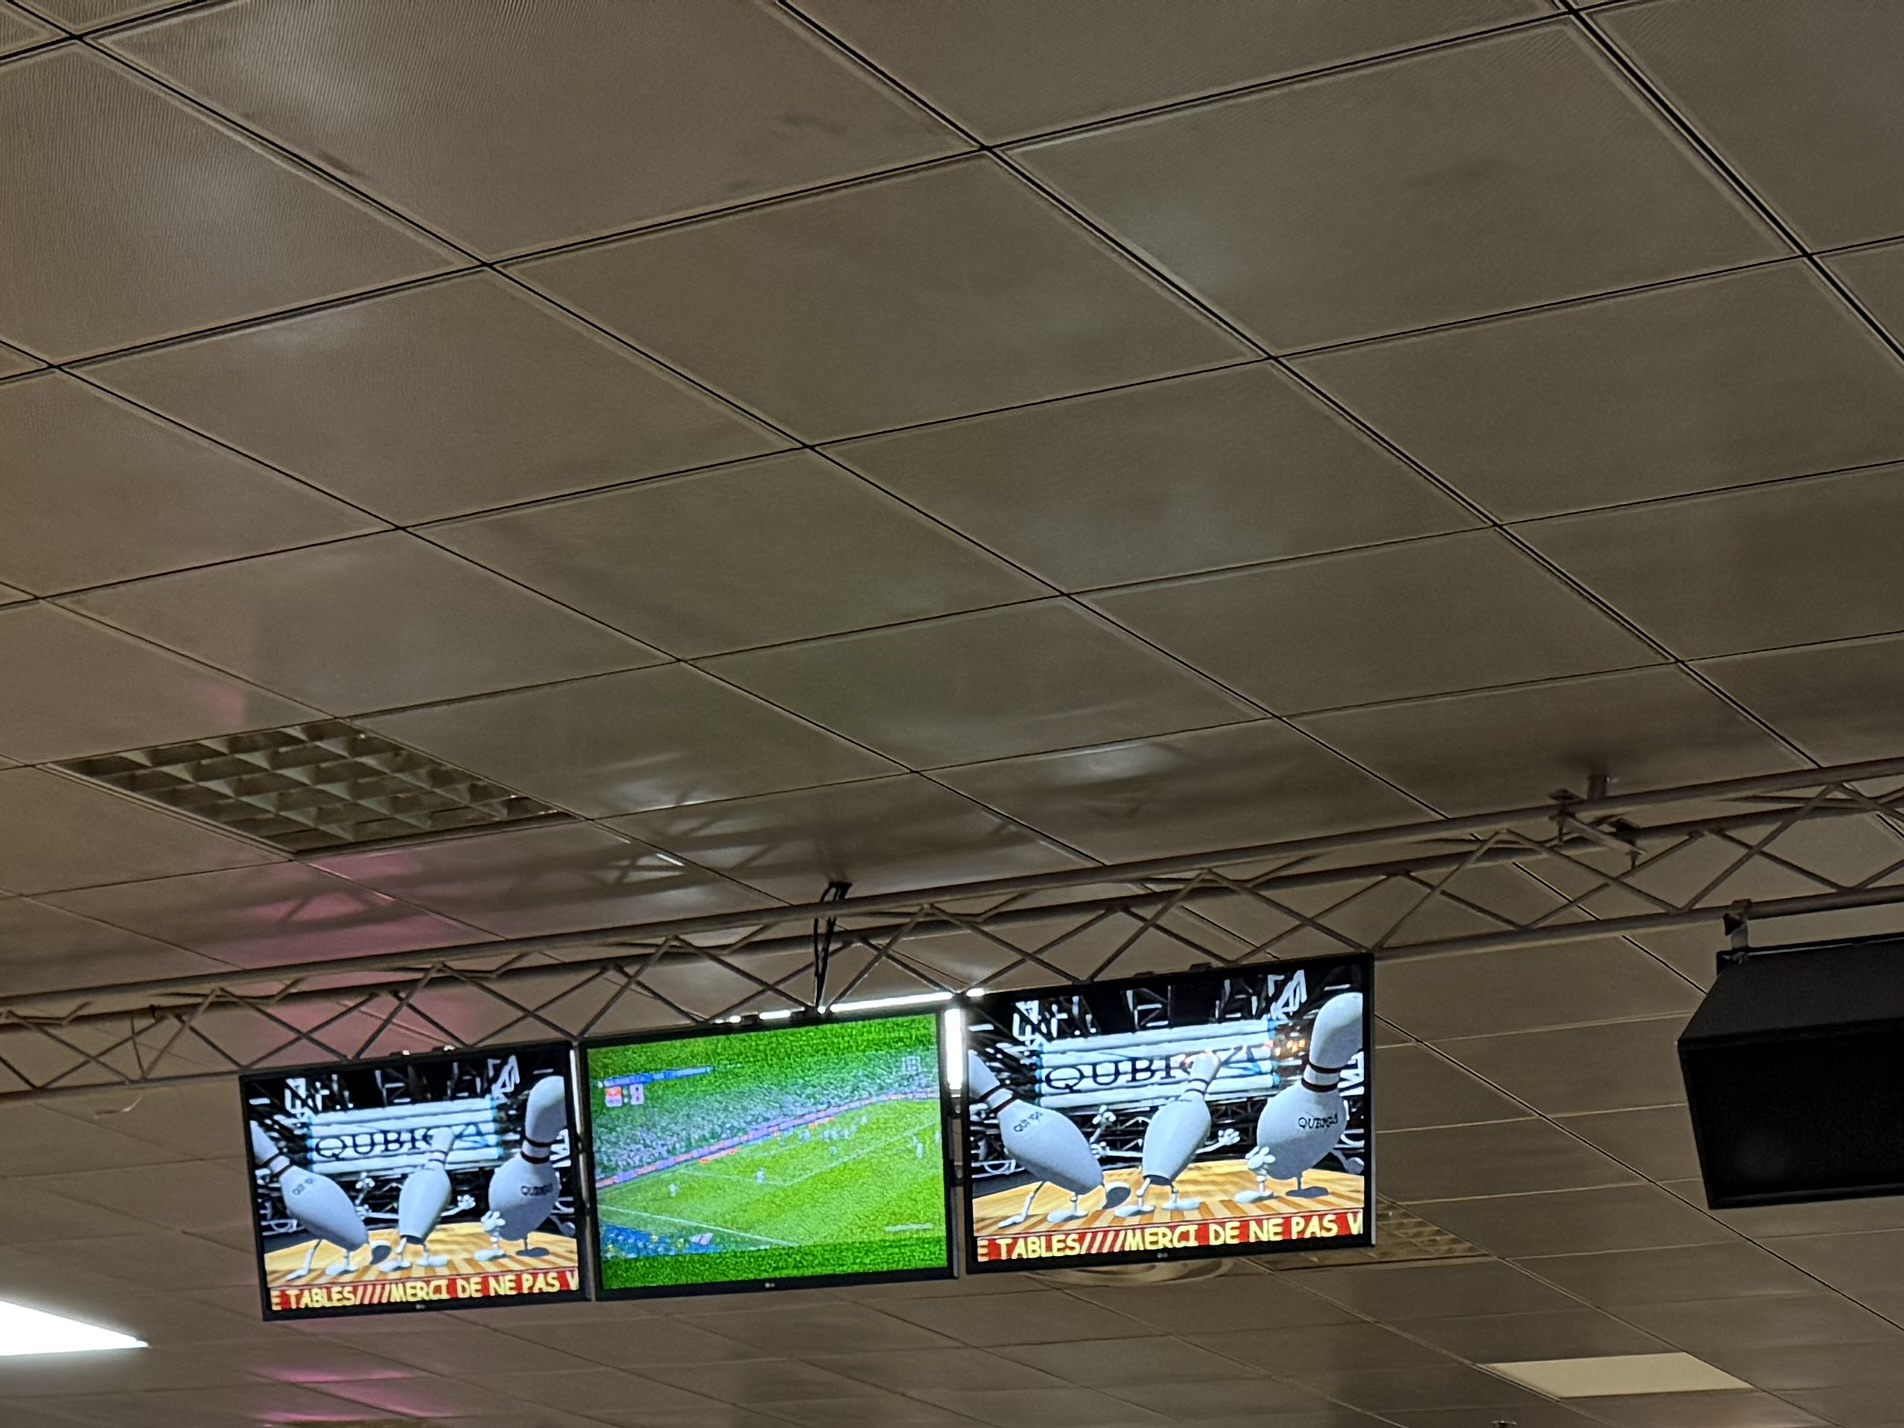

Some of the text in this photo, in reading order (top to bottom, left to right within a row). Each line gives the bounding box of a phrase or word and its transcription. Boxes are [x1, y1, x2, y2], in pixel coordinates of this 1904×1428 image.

[1209, 1222, 1241, 1245] DE
[1249, 1219, 1283, 1242] NE
[1292, 1215, 1339, 1239] PAS
[456, 1278, 482, 1298] DE
[489, 1274, 517, 1295] NE
[522, 1271, 560, 1293] PAS
